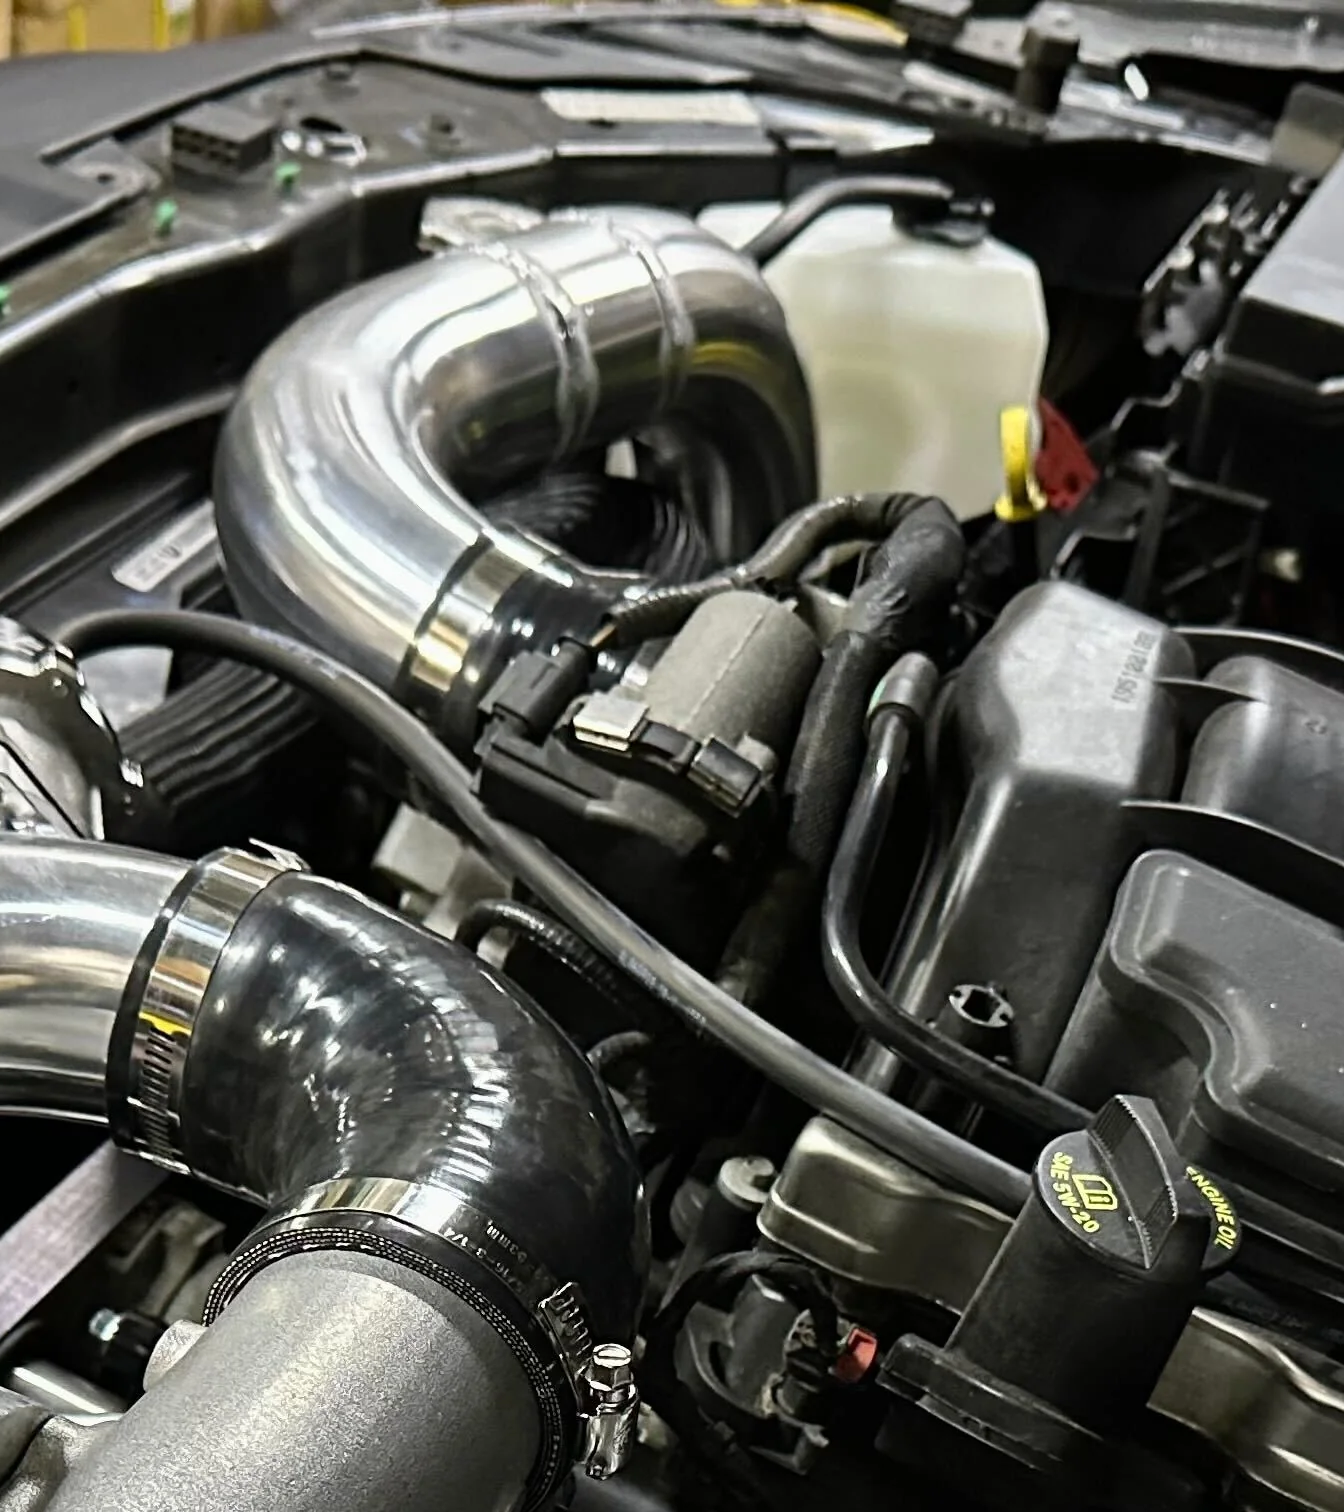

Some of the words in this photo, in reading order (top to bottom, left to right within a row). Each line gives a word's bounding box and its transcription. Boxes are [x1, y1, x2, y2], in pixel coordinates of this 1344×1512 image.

[1051, 1151, 1073, 1181] SAE
[1052, 1182, 1100, 1233] 5W-20
[1185, 1166, 1235, 1224] ENGINE
[1213, 1223, 1238, 1250] OIL
